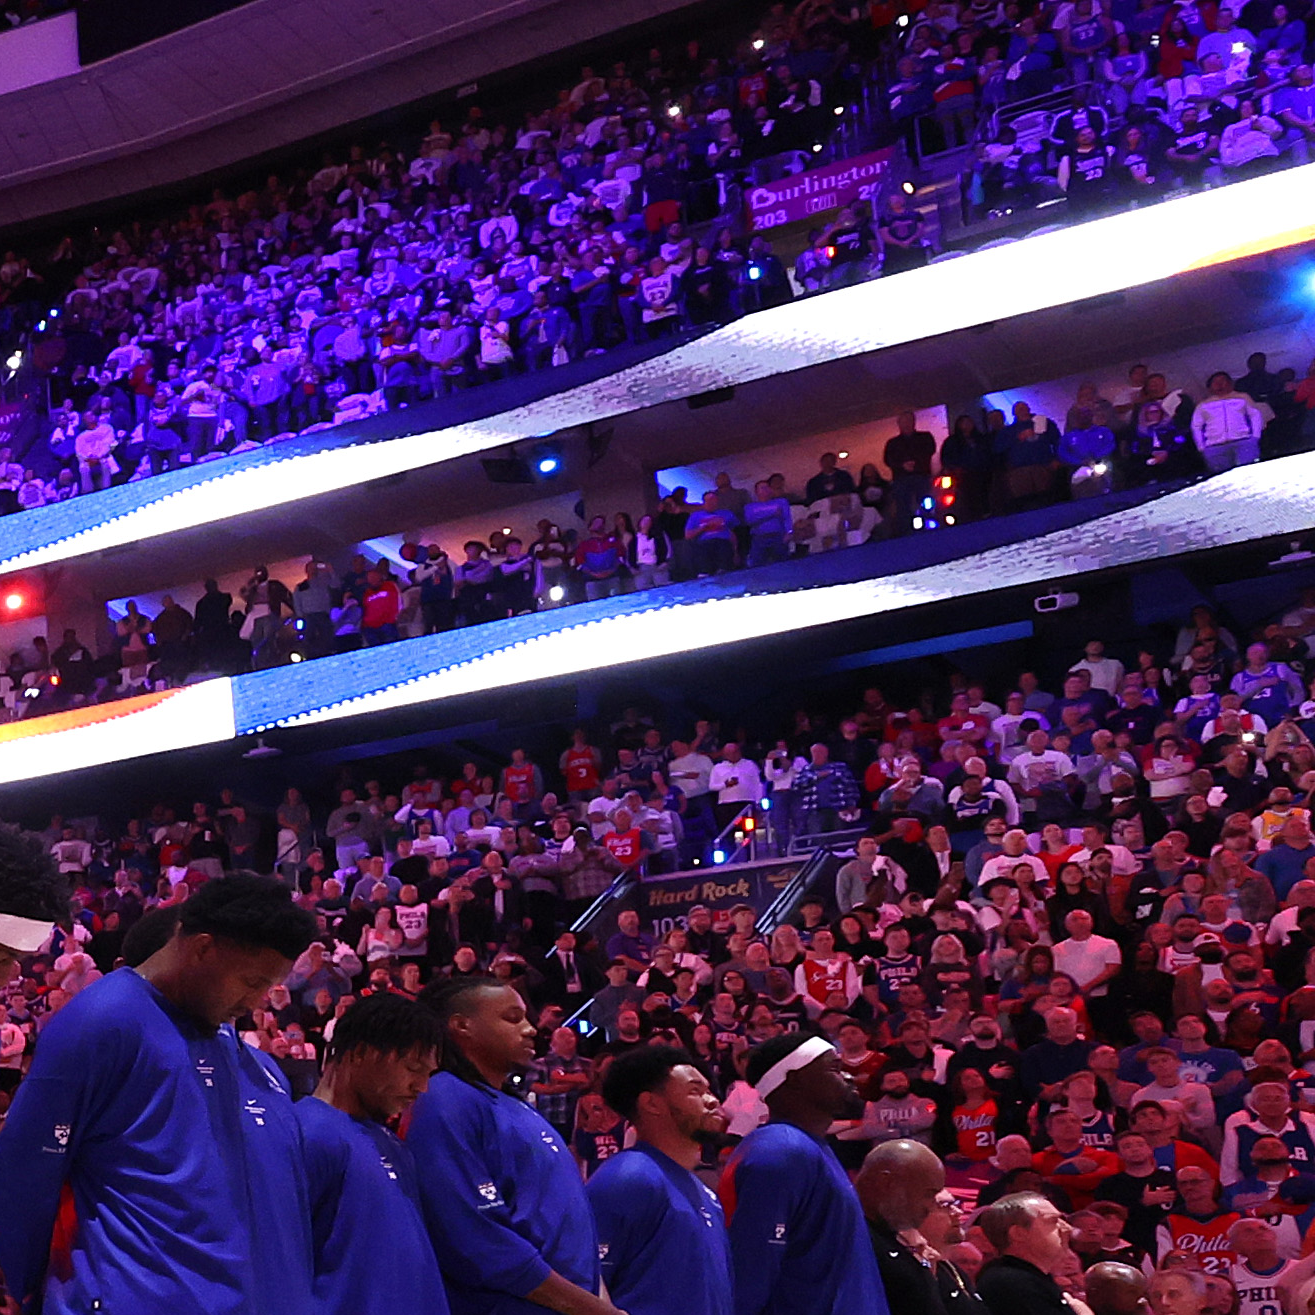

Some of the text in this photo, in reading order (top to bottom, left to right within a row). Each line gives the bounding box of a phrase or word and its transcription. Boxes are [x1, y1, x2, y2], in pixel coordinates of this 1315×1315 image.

[753, 209, 788, 231] 203
[702, 877, 750, 901] Rock
[975, 1130, 997, 1147] 21
